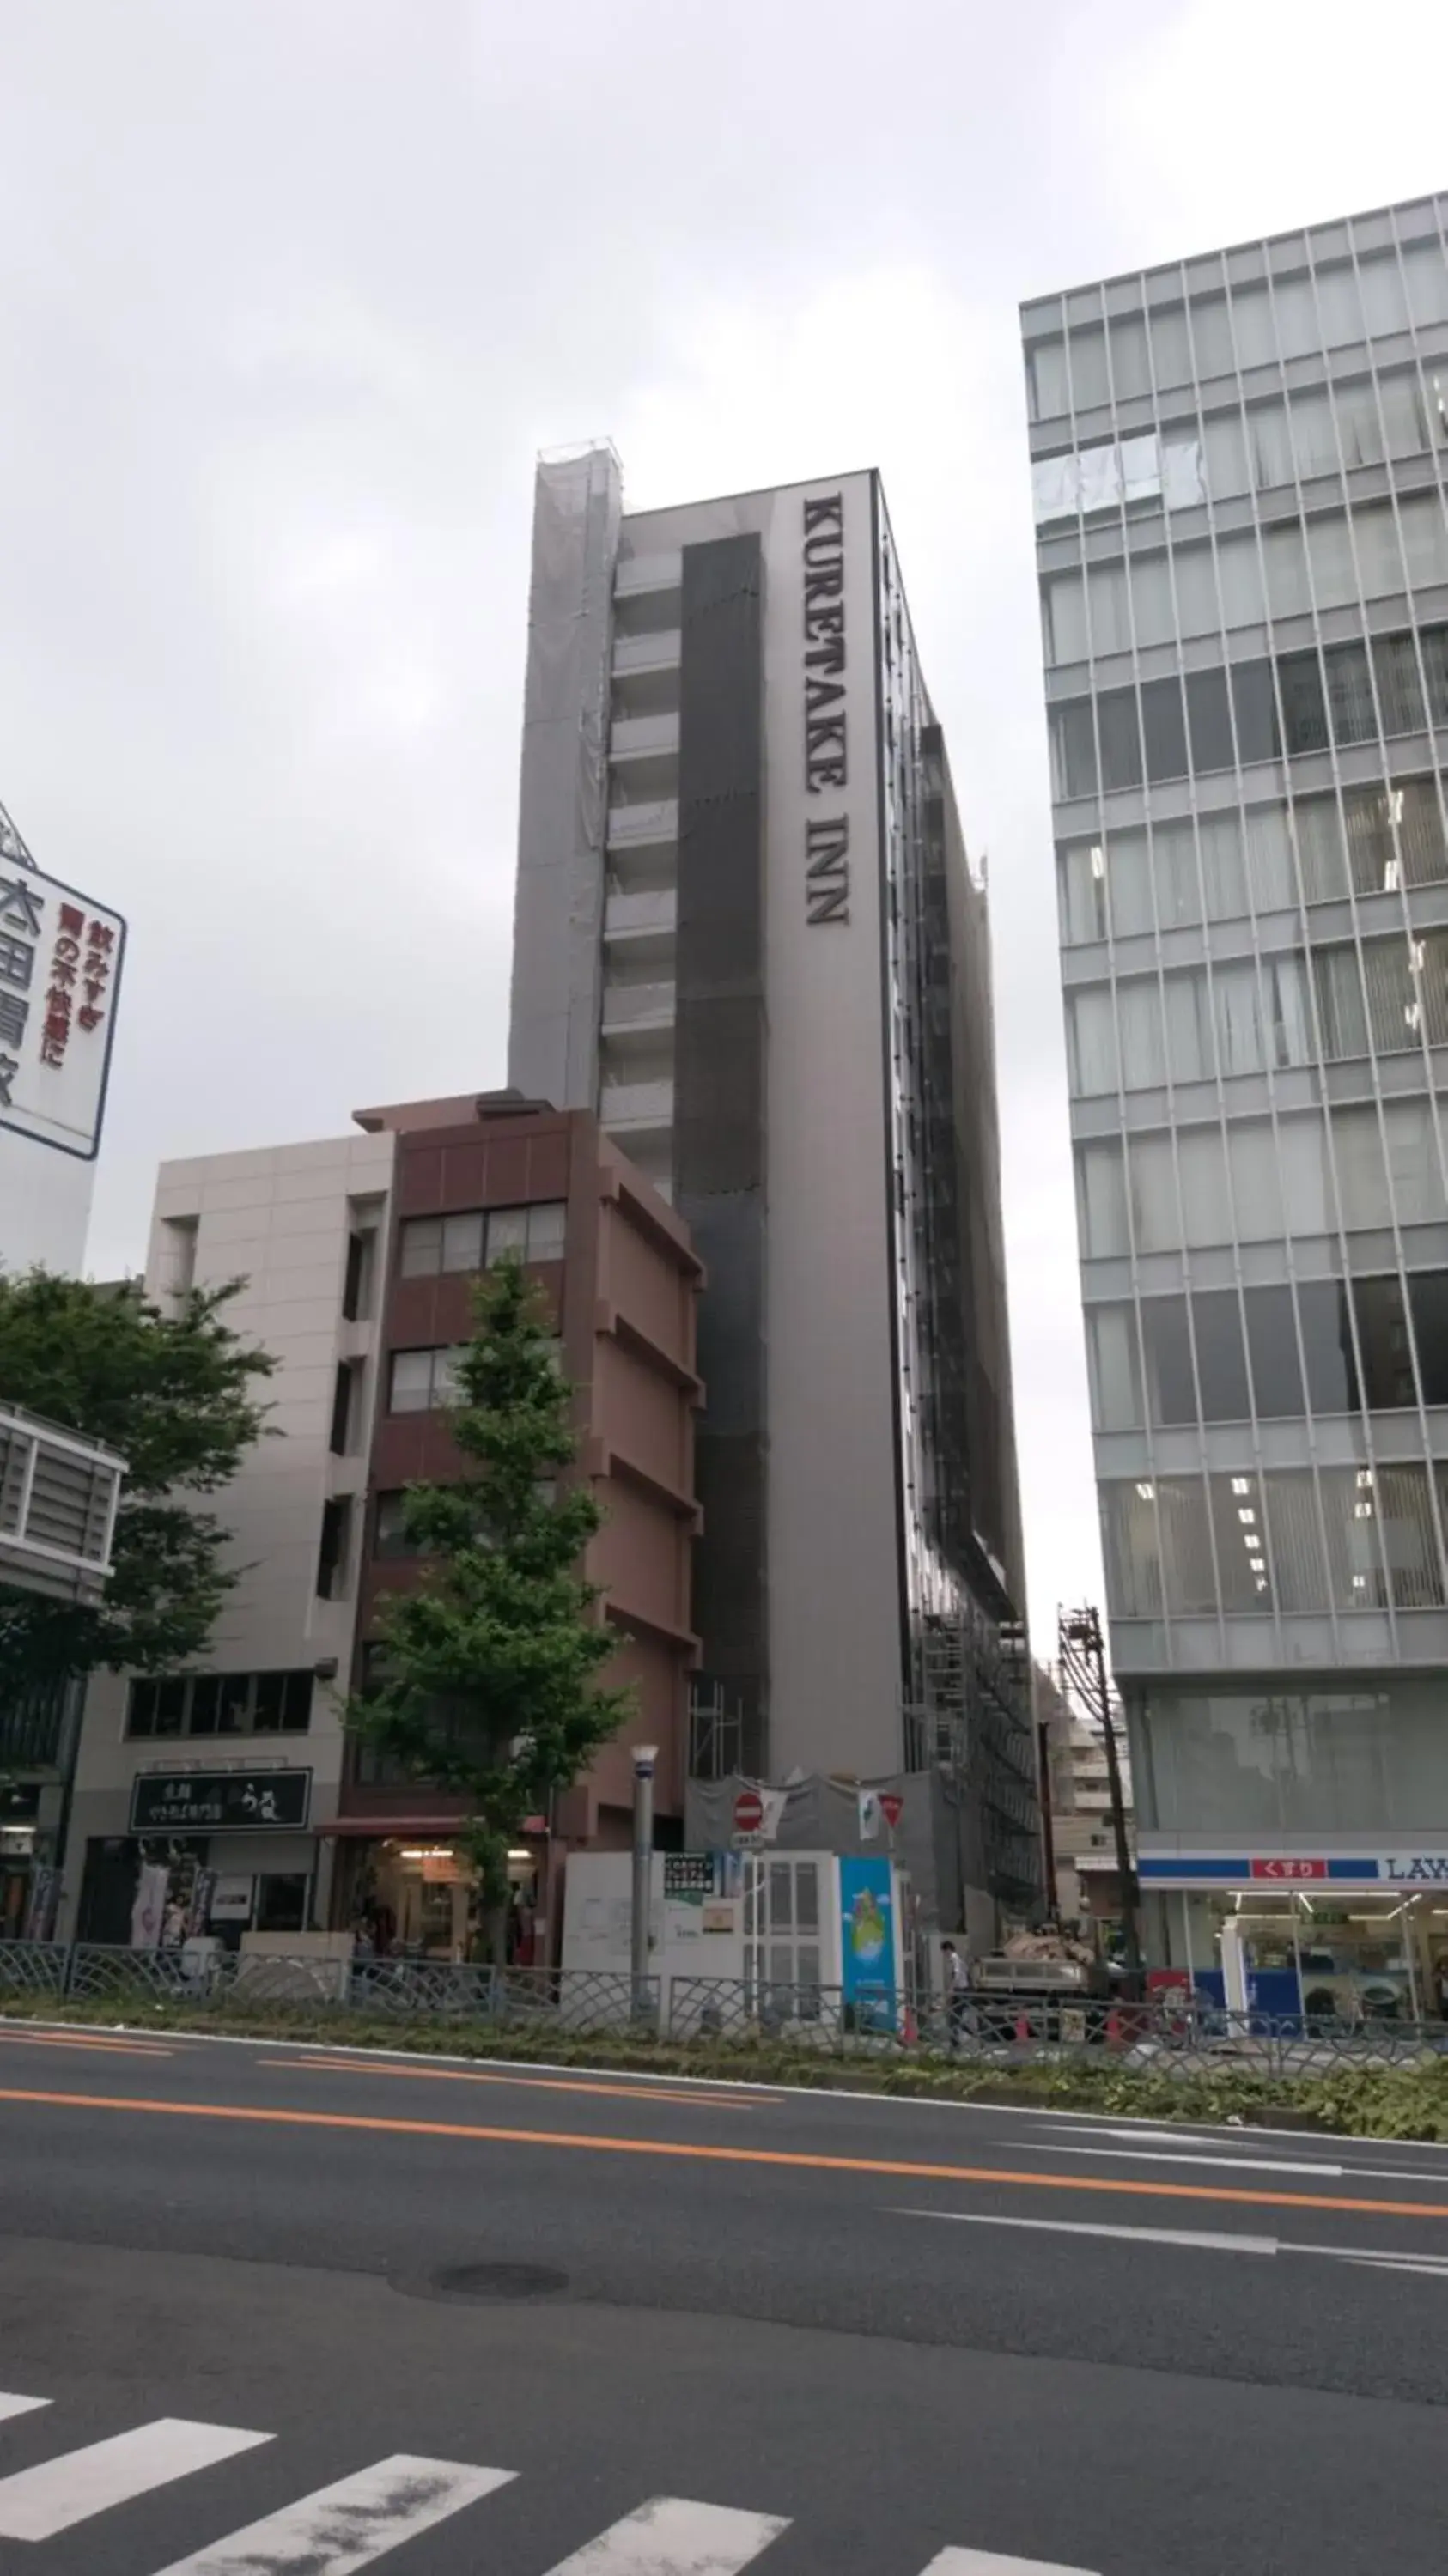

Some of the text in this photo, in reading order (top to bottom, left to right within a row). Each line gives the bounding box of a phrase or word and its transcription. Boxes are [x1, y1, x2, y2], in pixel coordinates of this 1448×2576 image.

[803, 491, 849, 928] KURETAKE INN
[1263, 1861, 1313, 1877] くすり
[1384, 1857, 1448, 1880] LAW
